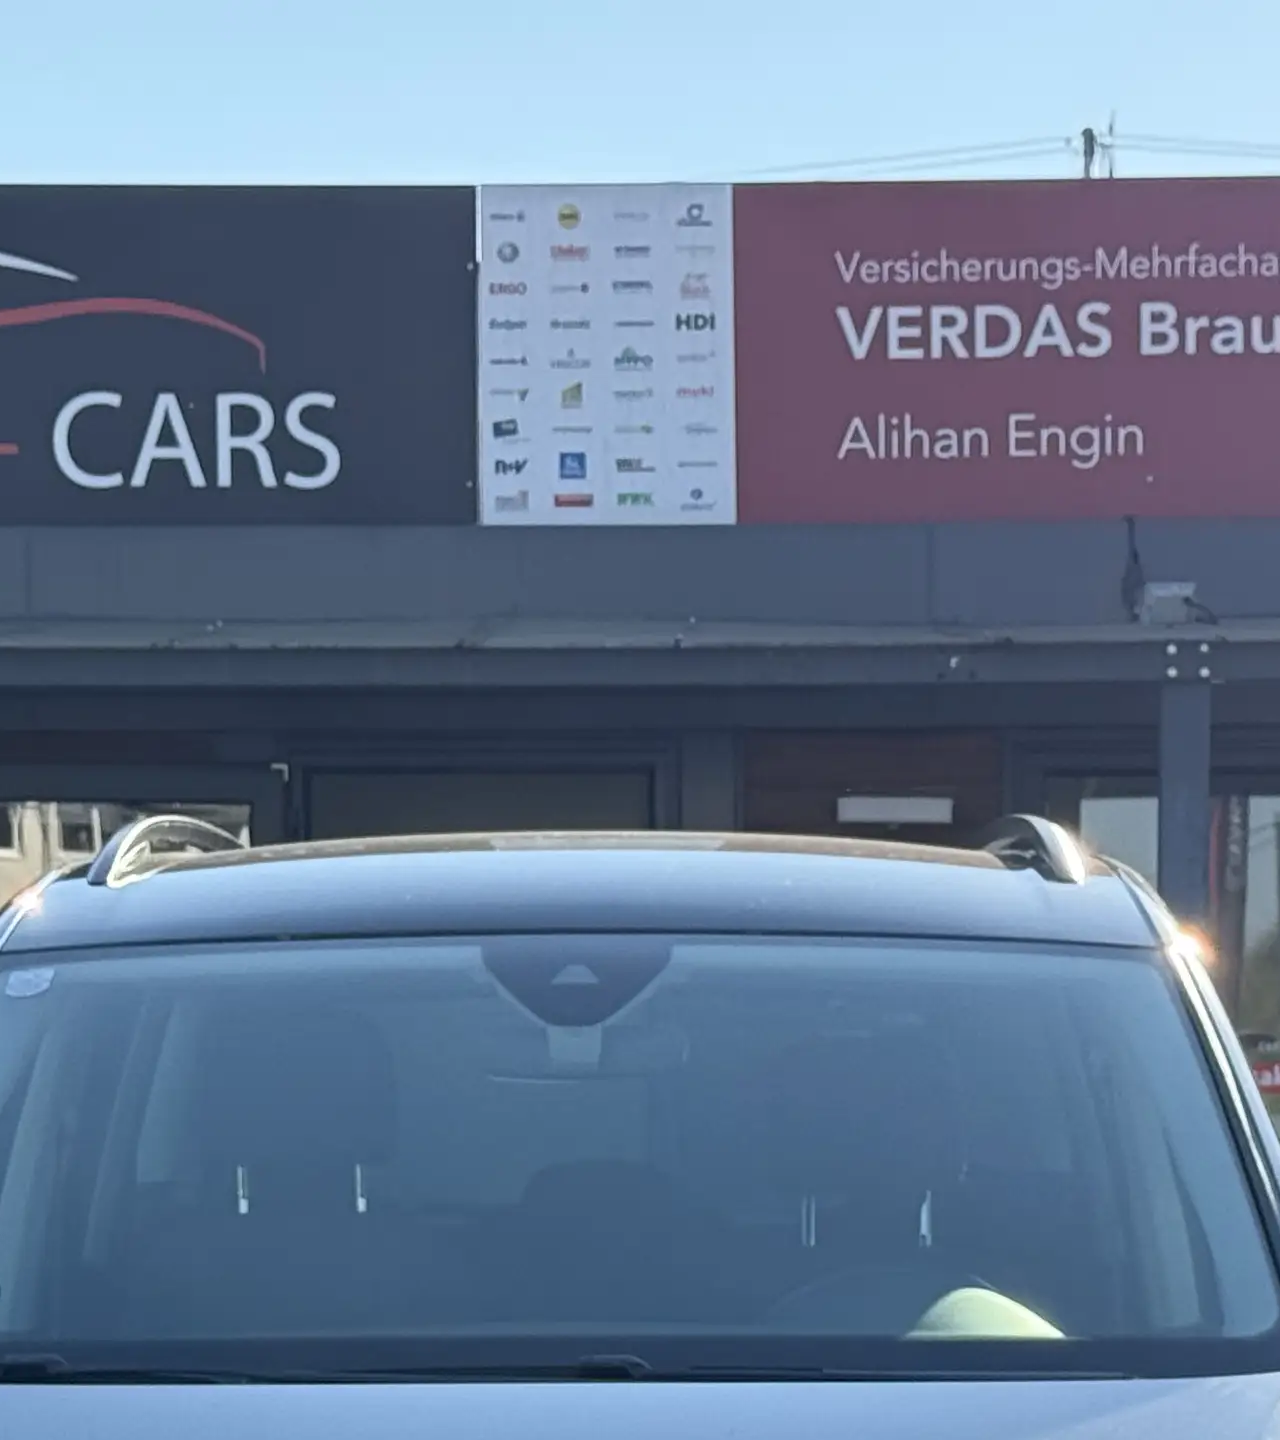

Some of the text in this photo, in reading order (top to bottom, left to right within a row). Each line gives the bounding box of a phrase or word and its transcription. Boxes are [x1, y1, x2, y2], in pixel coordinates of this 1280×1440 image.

[675, 312, 716, 332] HDI
[835, 301, 1112, 360] VERDAS
[52, 391, 341, 489] CARS
[837, 412, 1144, 470] Alihan Engin
